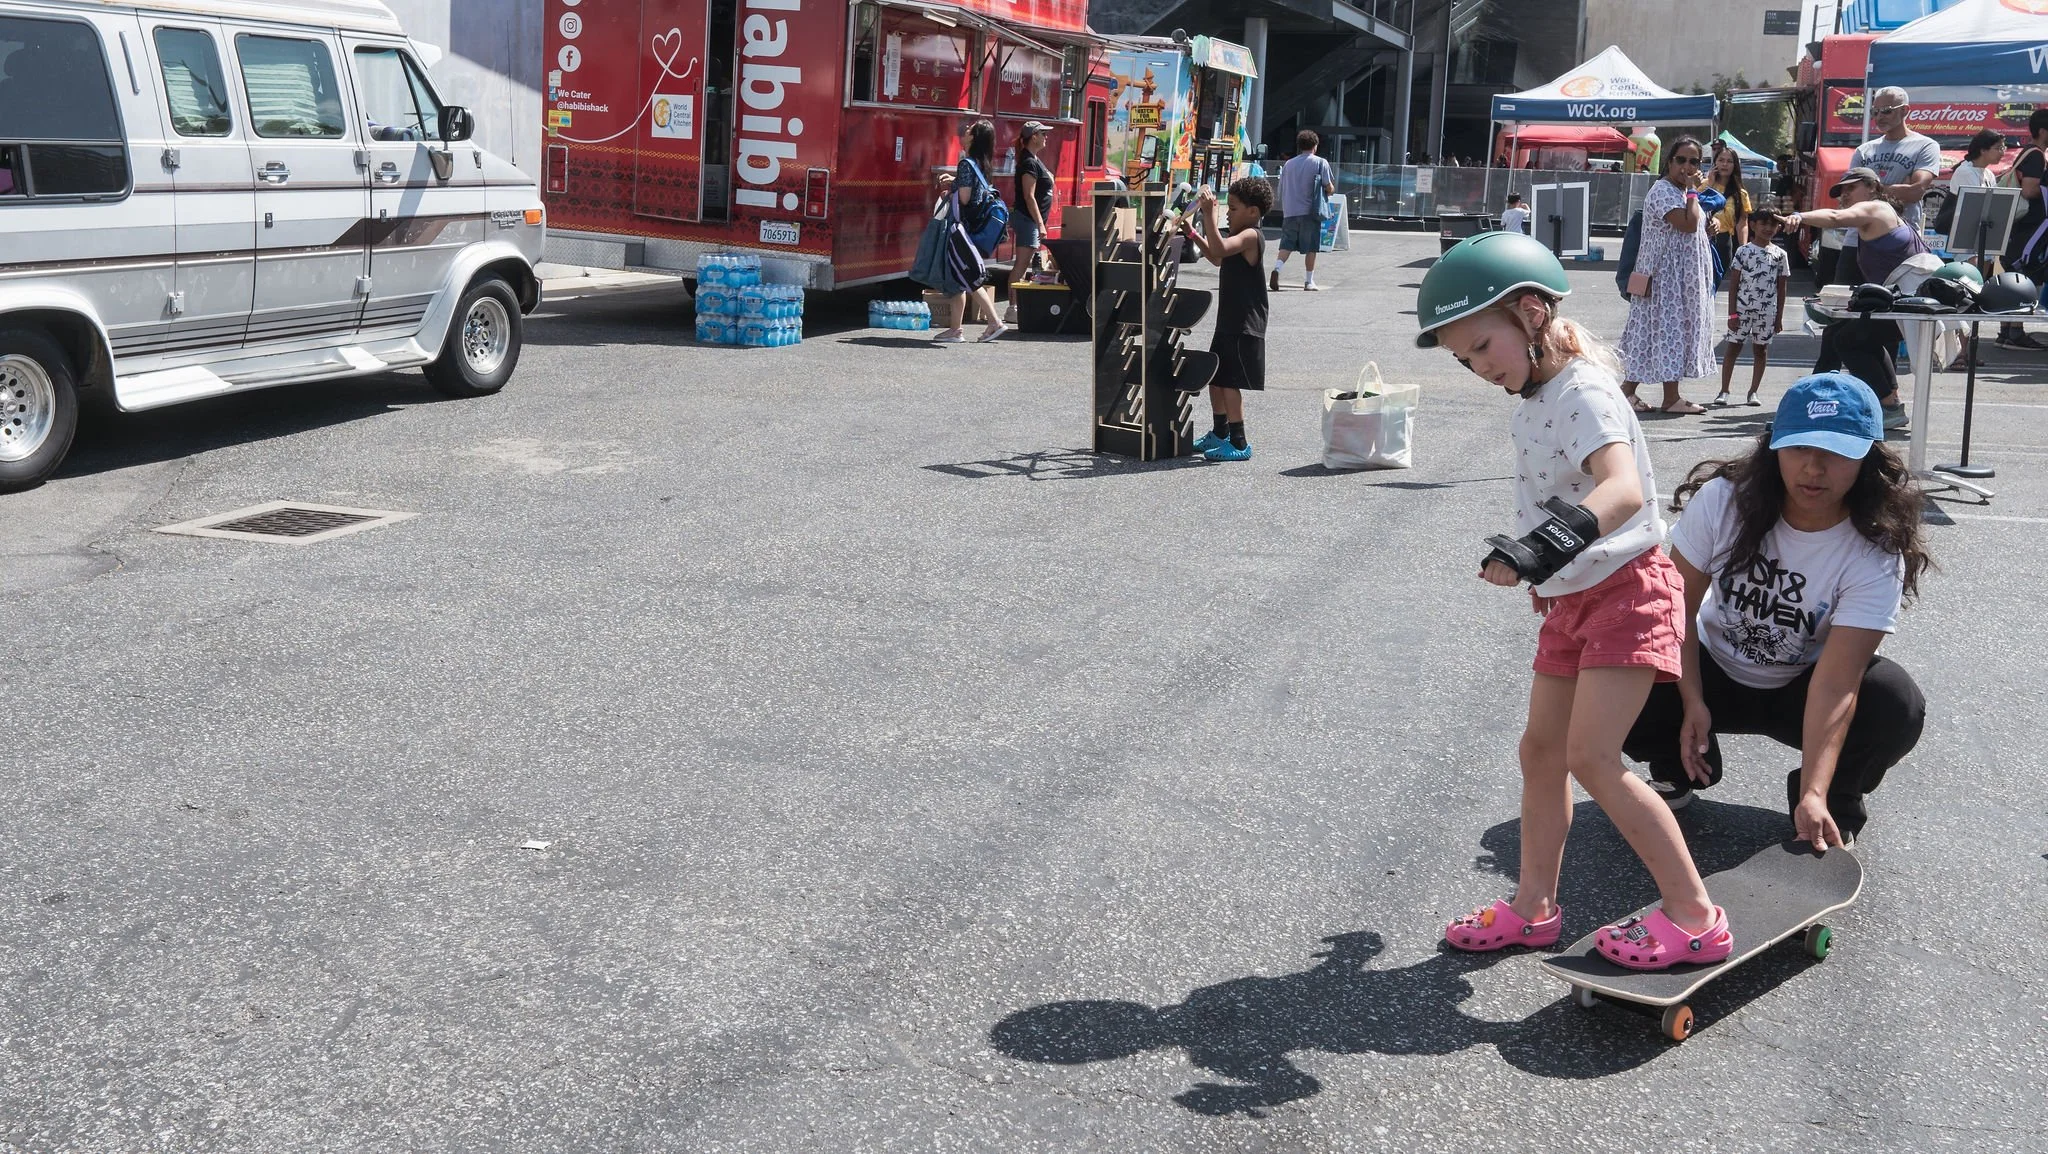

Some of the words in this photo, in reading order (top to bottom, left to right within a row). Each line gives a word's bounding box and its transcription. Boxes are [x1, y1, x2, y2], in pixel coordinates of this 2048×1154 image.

[557, 89, 570, 98] We
[571, 90, 592, 99] Cater
[557, 101, 609, 112] @habibishack
[1567, 103, 1637, 119] WCK.org
[673, 111, 691, 119] Central
[1861, 152, 1915, 170] PALISADES
[763, 229, 797, 242] 70659T3
[1435, 295, 1469, 316] thousand
[1806, 400, 1839, 417] Vans
[1545, 524, 1575, 548] Gonex
[1724, 577, 1816, 636] HAVEN
